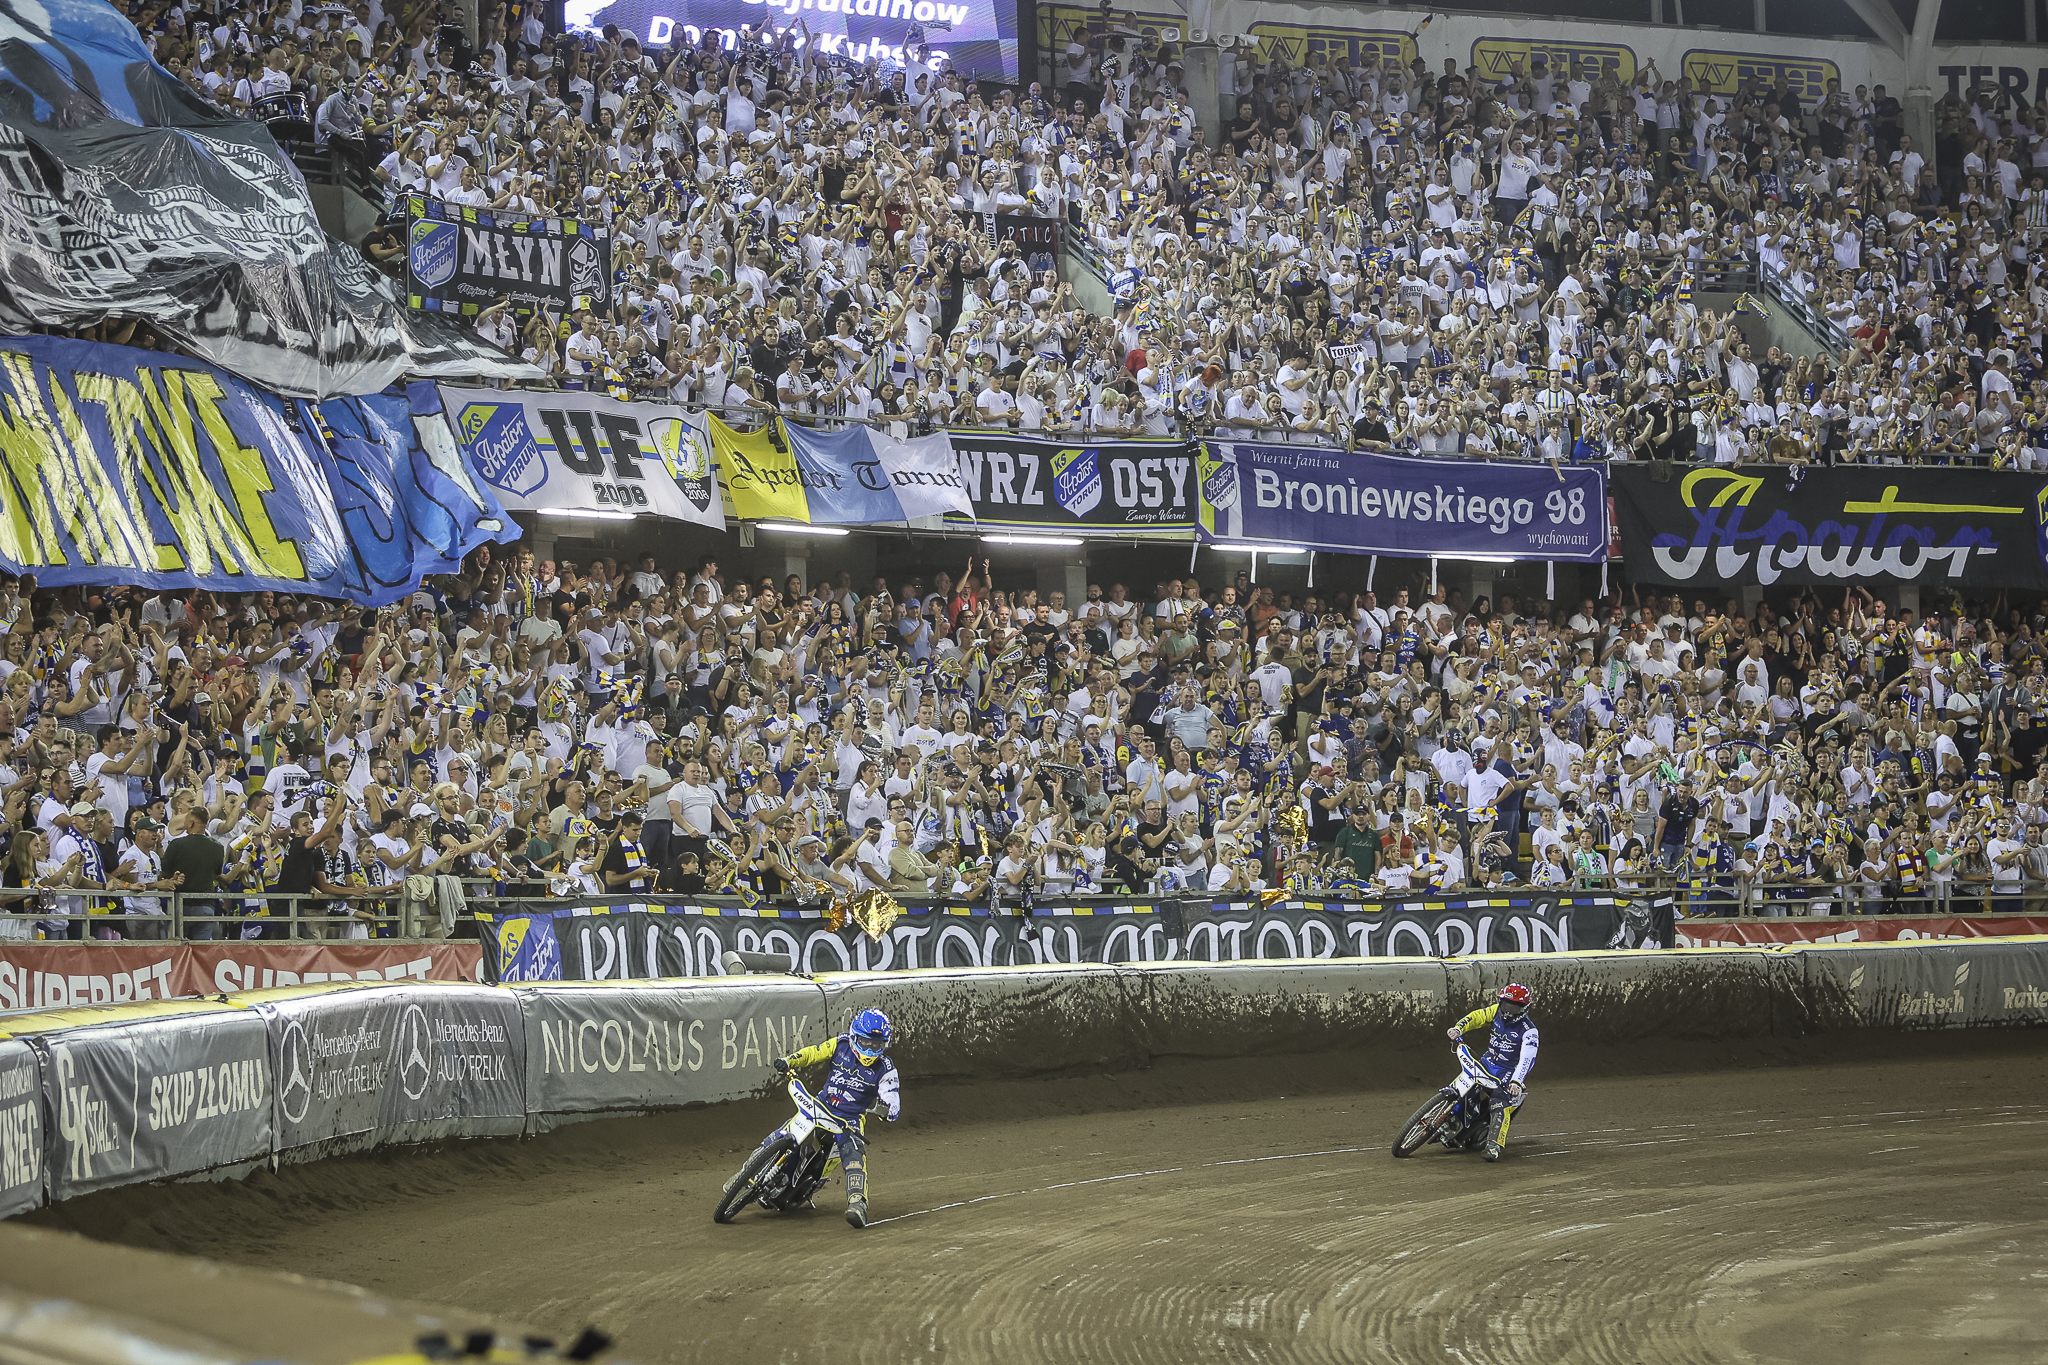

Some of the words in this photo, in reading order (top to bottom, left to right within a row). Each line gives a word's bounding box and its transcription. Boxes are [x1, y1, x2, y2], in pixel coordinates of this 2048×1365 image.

[463, 226, 563, 287] MŁYN
[465, 412, 483, 442] KS
[475, 411, 525, 477] Apator
[538, 408, 646, 480] UF
[1251, 449, 1293, 466] Wierni
[1295, 452, 1321, 469] fani
[1324, 458, 1341, 469] na
[1054, 452, 1067, 470] KS
[954, 450, 1044, 505] WRZ
[1110, 457, 1190, 508] OSY
[1059, 453, 1096, 502] Apator
[592, 482, 649, 507] 2008
[686, 489, 710, 500] 2008
[1254, 467, 1534, 535] Broniewskiego
[1544, 487, 1586, 526] 98
[1125, 510, 1156, 523] Zawsze
[1158, 508, 1187, 521] Wierni
[1651, 468, 2024, 586] Apator
[1527, 530, 1590, 549] wychowani
[1899, 989, 1965, 1016] Raitech
[316, 1026, 382, 1059] Mercedes-Benz
[435, 1017, 505, 1043] Mercedes-Benz
[540, 1019, 705, 1074] NICOLAUS
[721, 1015, 808, 1070] BANK
[317, 1068, 345, 1100] AUTO
[346, 1061, 384, 1095] FRELIK
[436, 1055, 467, 1082] AUTO
[468, 1054, 506, 1081] FRELIK
[149, 1070, 195, 1131] SKUP
[196, 1058, 264, 1120] ZŁOMU
[793, 1091, 814, 1111] LAVOR
